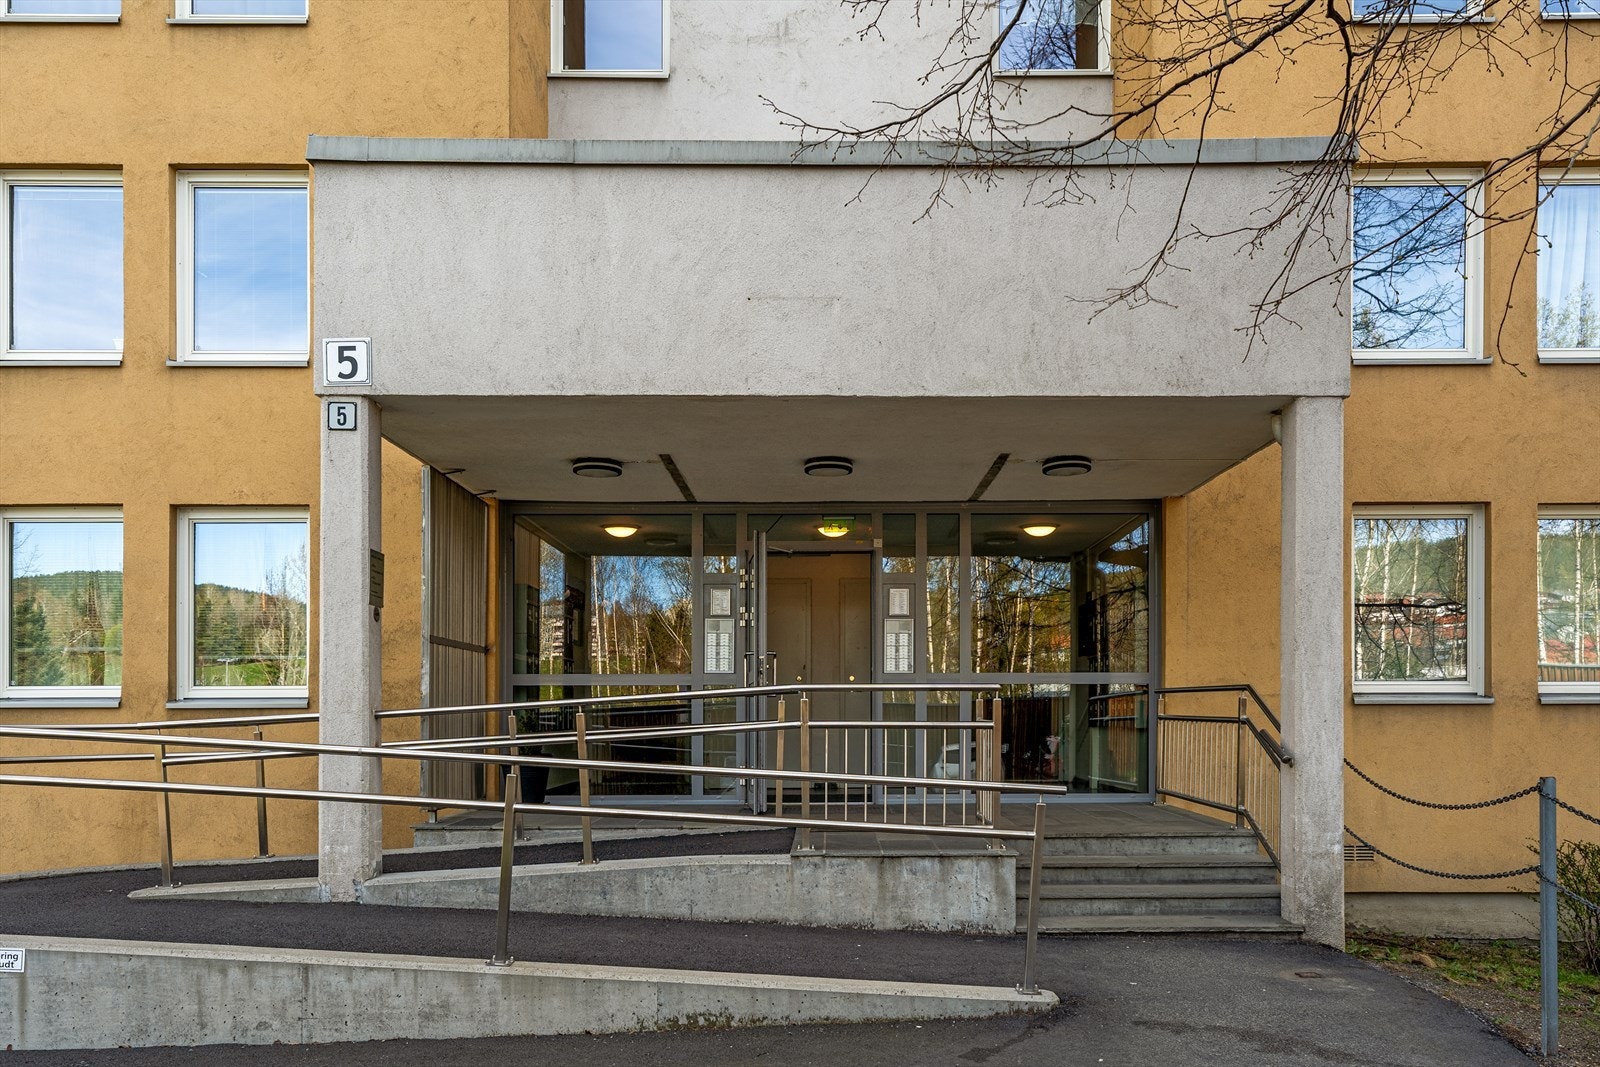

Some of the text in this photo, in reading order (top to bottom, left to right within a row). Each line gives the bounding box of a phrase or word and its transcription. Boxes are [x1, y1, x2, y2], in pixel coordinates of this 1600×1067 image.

[337, 345, 358, 380] 5
[337, 406, 347, 426] 5
[1, 952, 18, 961] ring
